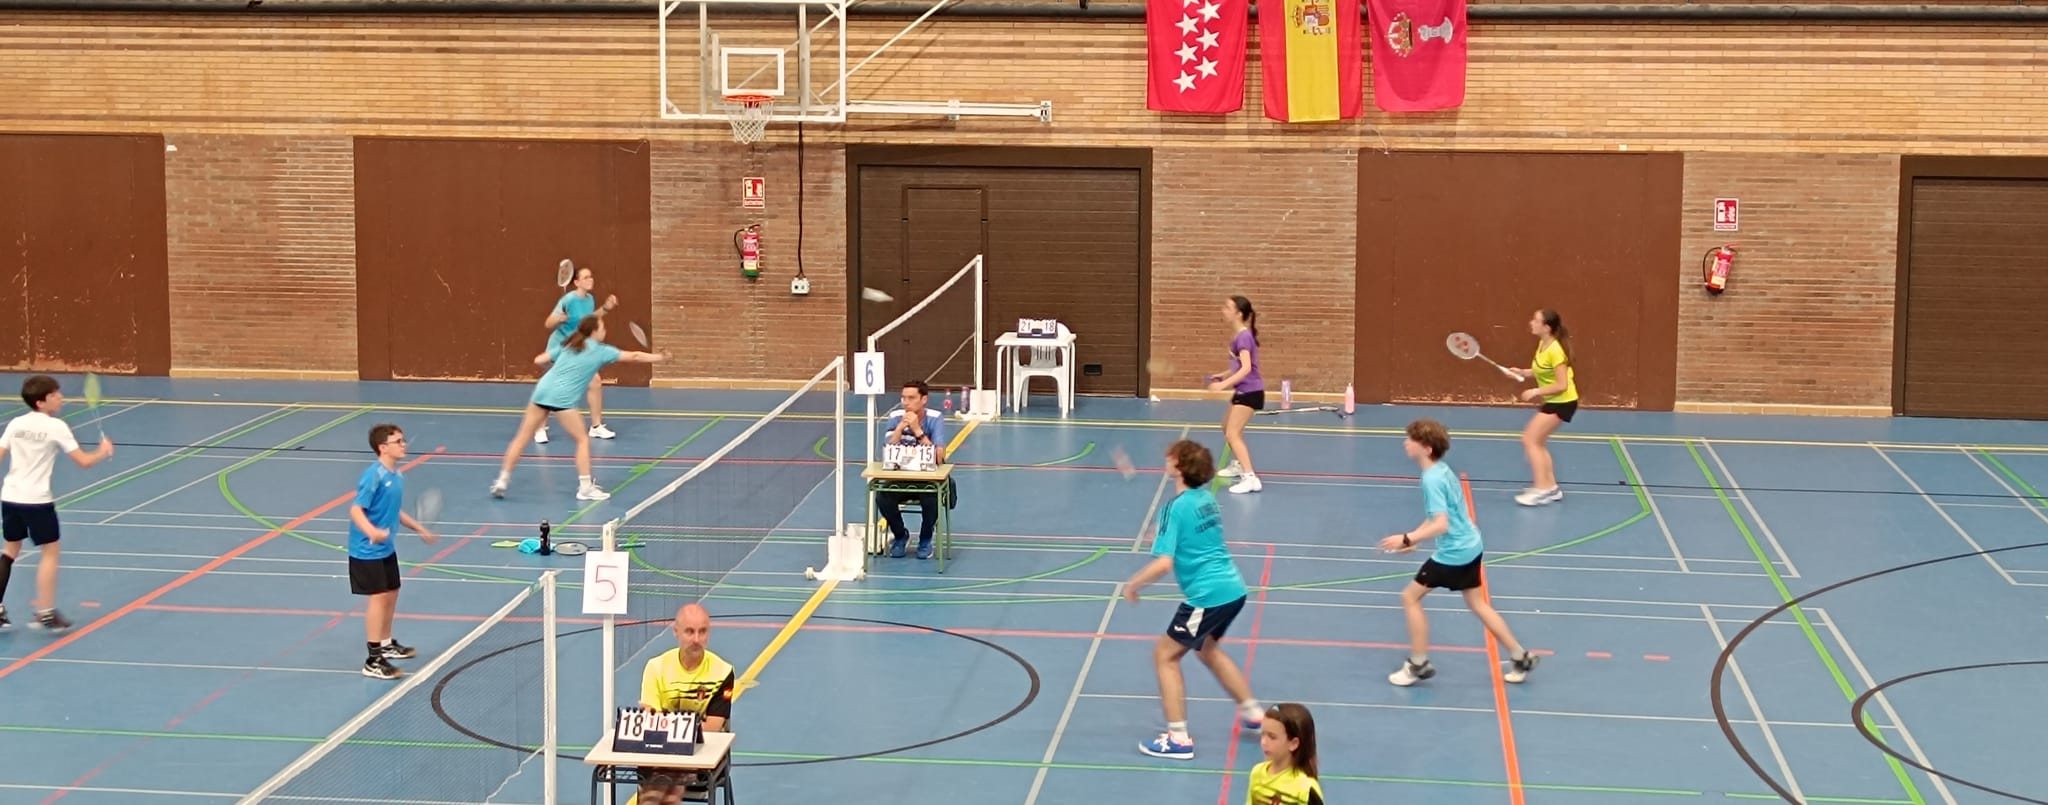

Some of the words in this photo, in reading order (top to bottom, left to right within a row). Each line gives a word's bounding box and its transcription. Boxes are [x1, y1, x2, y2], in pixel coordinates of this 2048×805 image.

[865, 359, 874, 388] 6
[888, 447, 900, 460] 17
[920, 447, 932, 462] 15
[595, 564, 618, 602] 5
[623, 714, 644, 737] 18
[671, 717, 692, 740] 17
